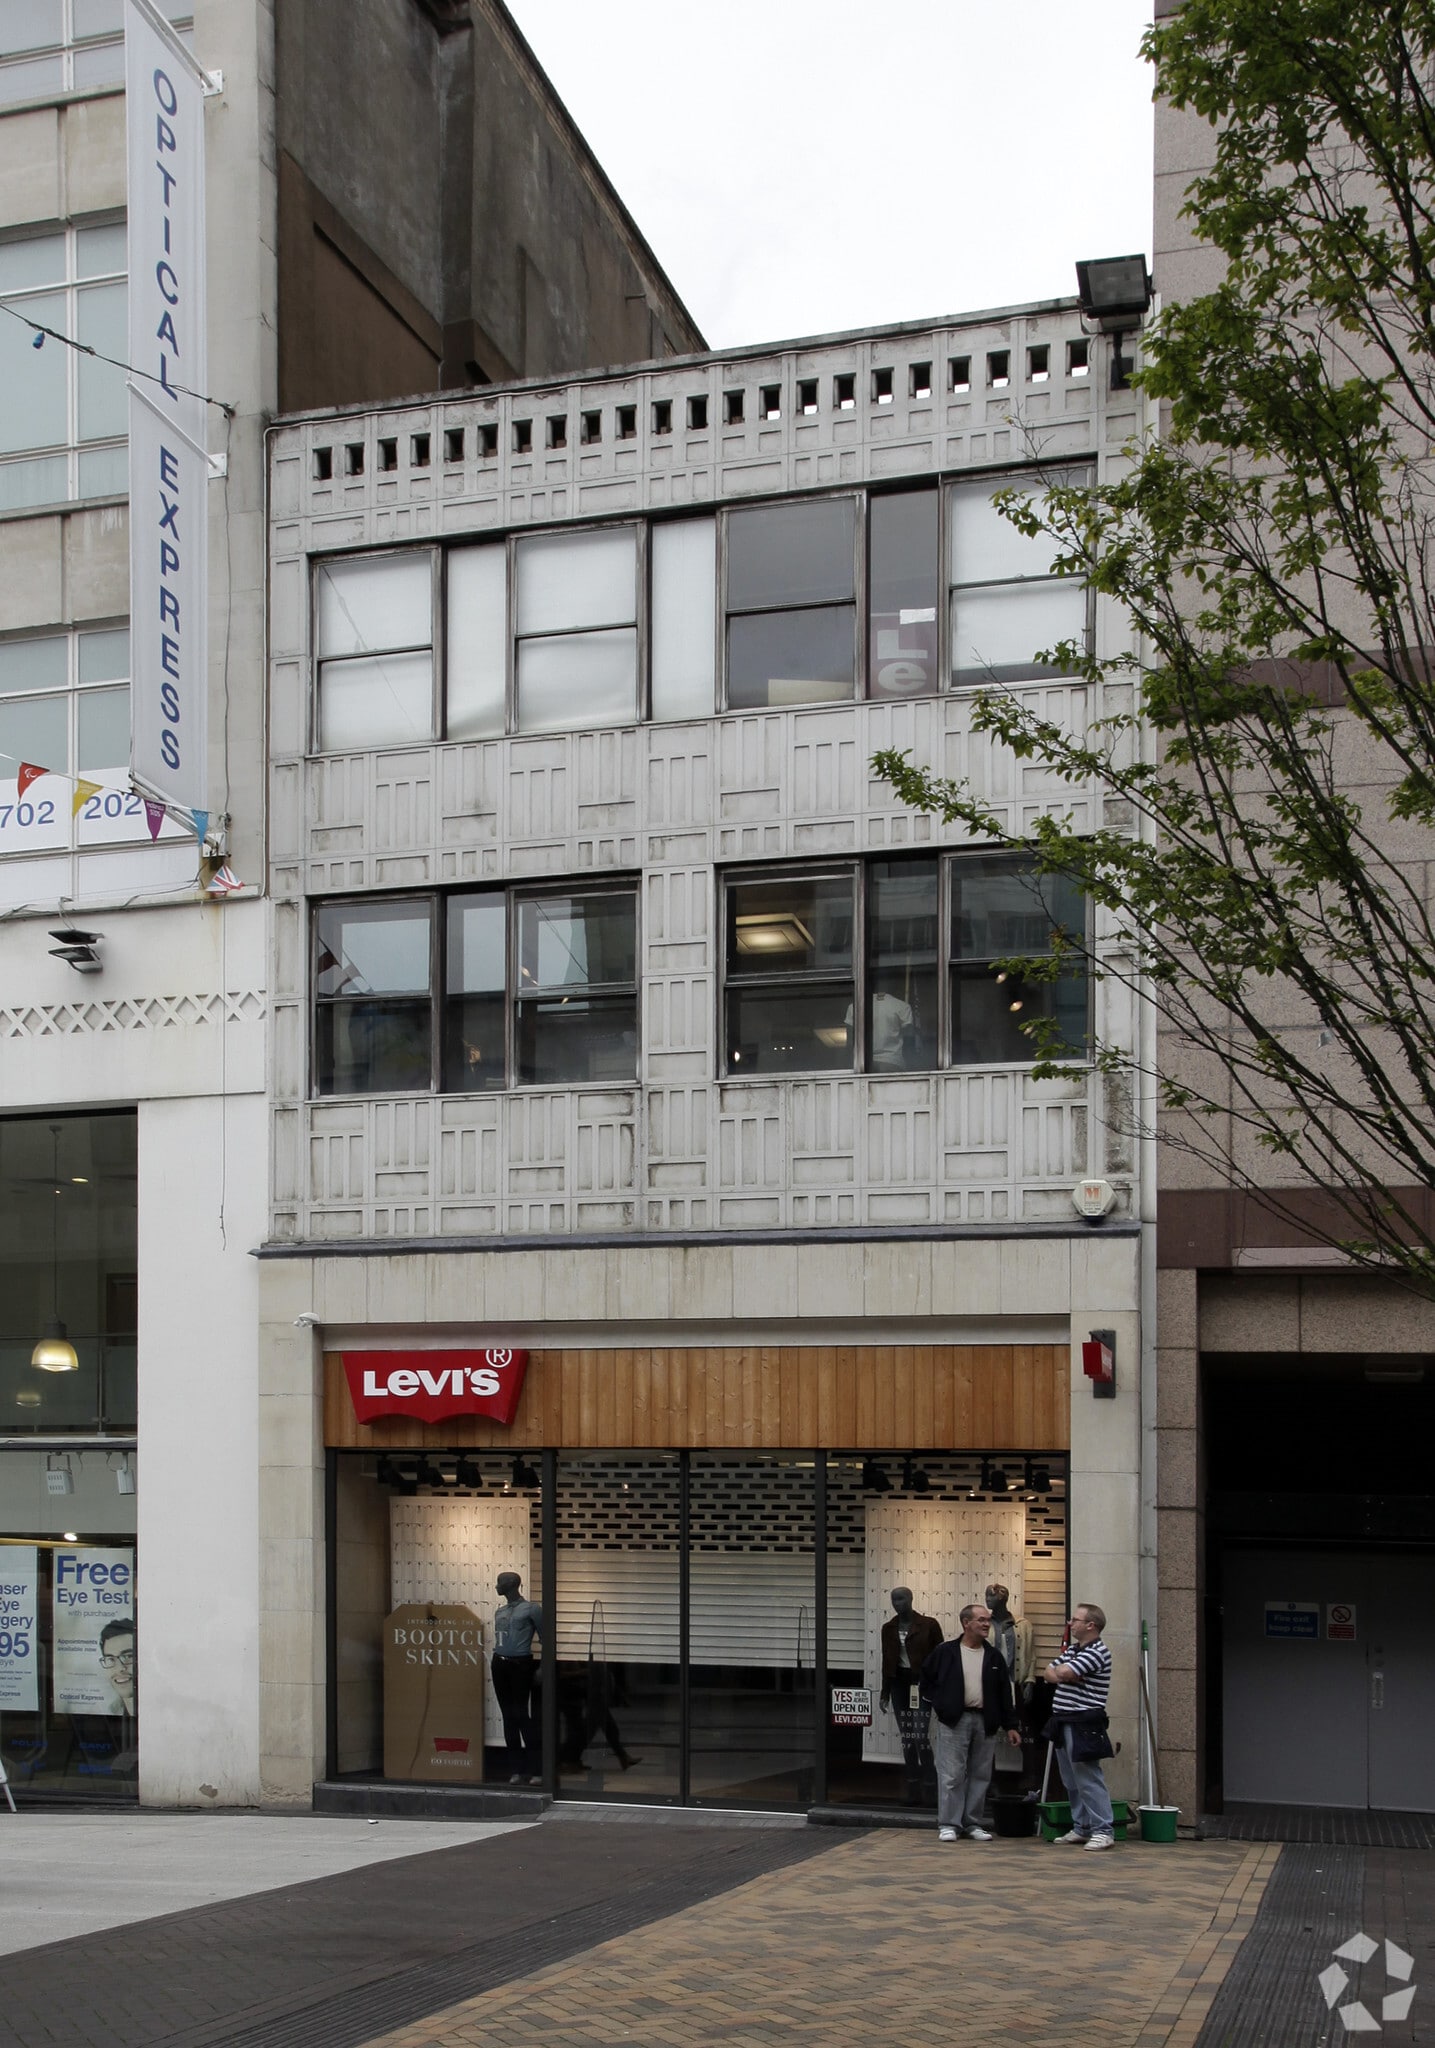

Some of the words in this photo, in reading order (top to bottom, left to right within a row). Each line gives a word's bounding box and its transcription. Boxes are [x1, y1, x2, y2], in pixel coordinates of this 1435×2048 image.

[153, 68, 179, 402] OPTICAL
[158, 444, 181, 770] EXPRESS
[57, 1555, 130, 1586] Free
[57, 1588, 88, 1606] Eye
[92, 1588, 130, 1604] Test
[834, 1691, 853, 1702] YES
[834, 1703, 856, 1713] OPEN
[858, 1704, 870, 1713] ON
[834, 1715, 869, 1724] LEVI.COM
